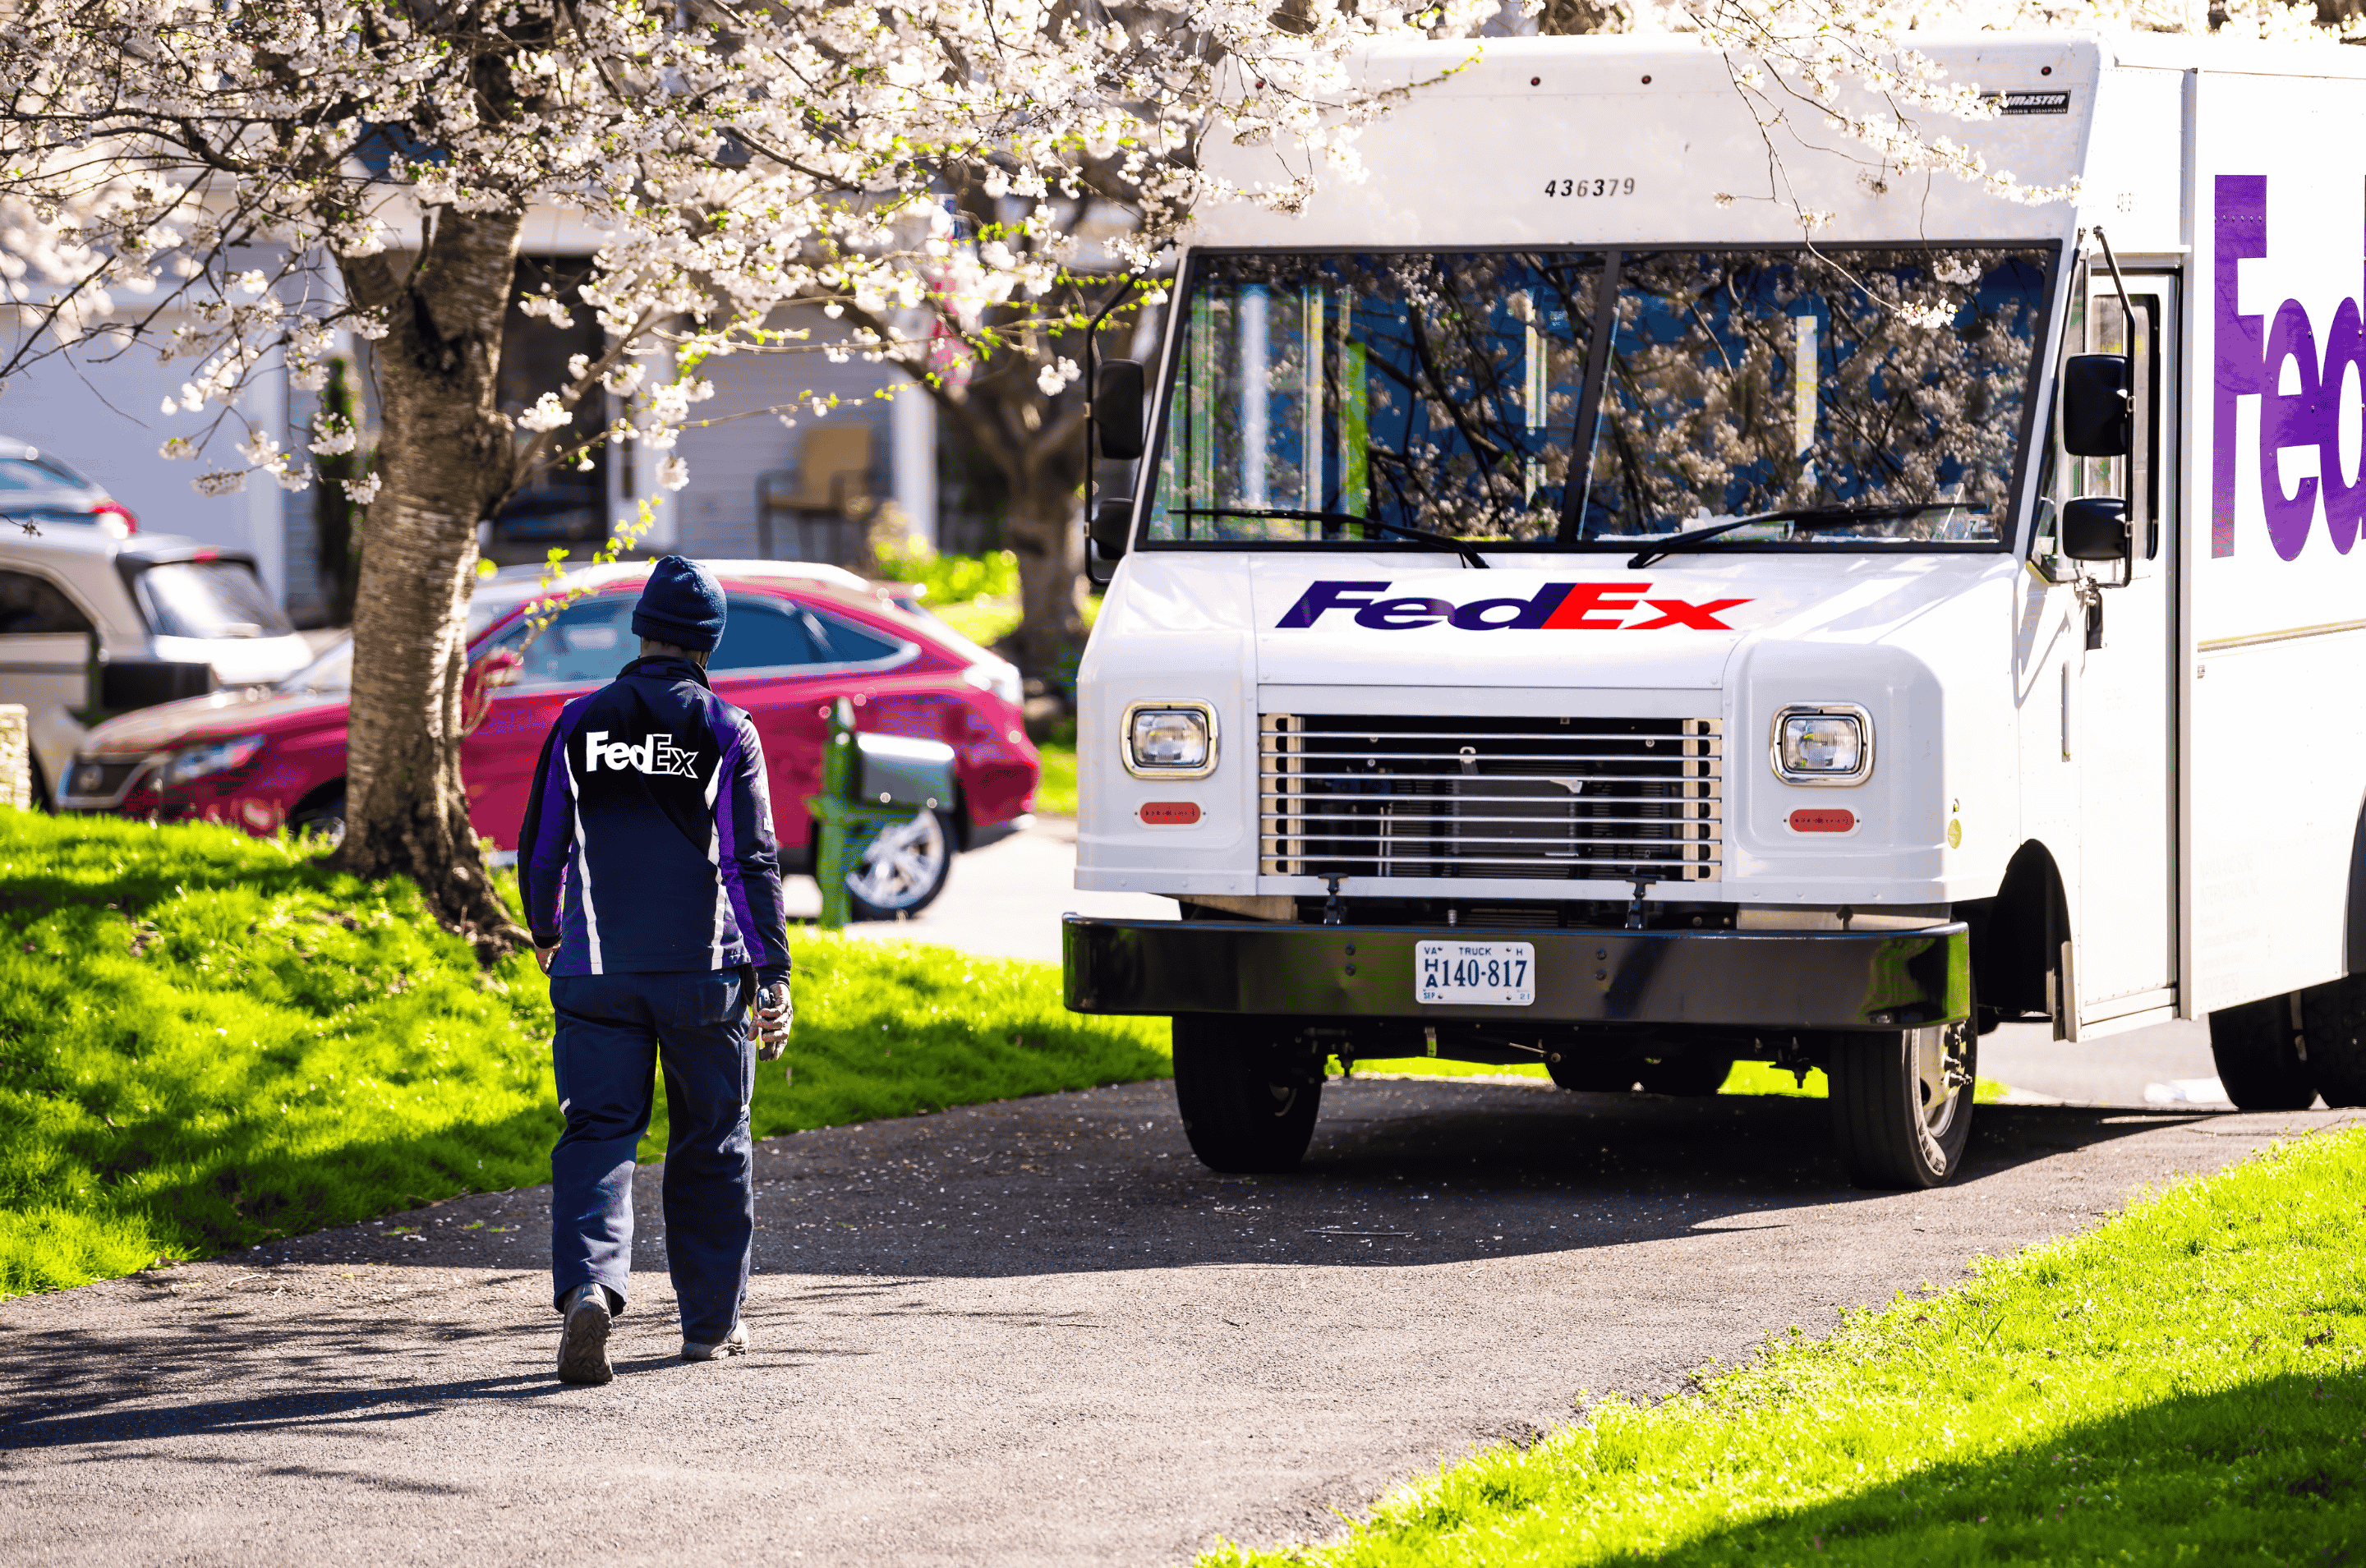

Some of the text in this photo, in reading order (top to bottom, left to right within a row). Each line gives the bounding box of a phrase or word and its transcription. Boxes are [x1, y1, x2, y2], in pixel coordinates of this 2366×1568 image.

[1981, 94, 2066, 106] IMASTER
[1544, 177, 1636, 198] 436379
[1275, 580, 1758, 631] FedEx
[586, 730, 699, 779] FedEx
[1424, 947, 1438, 955] VA
[1458, 947, 1492, 956] TRUCK
